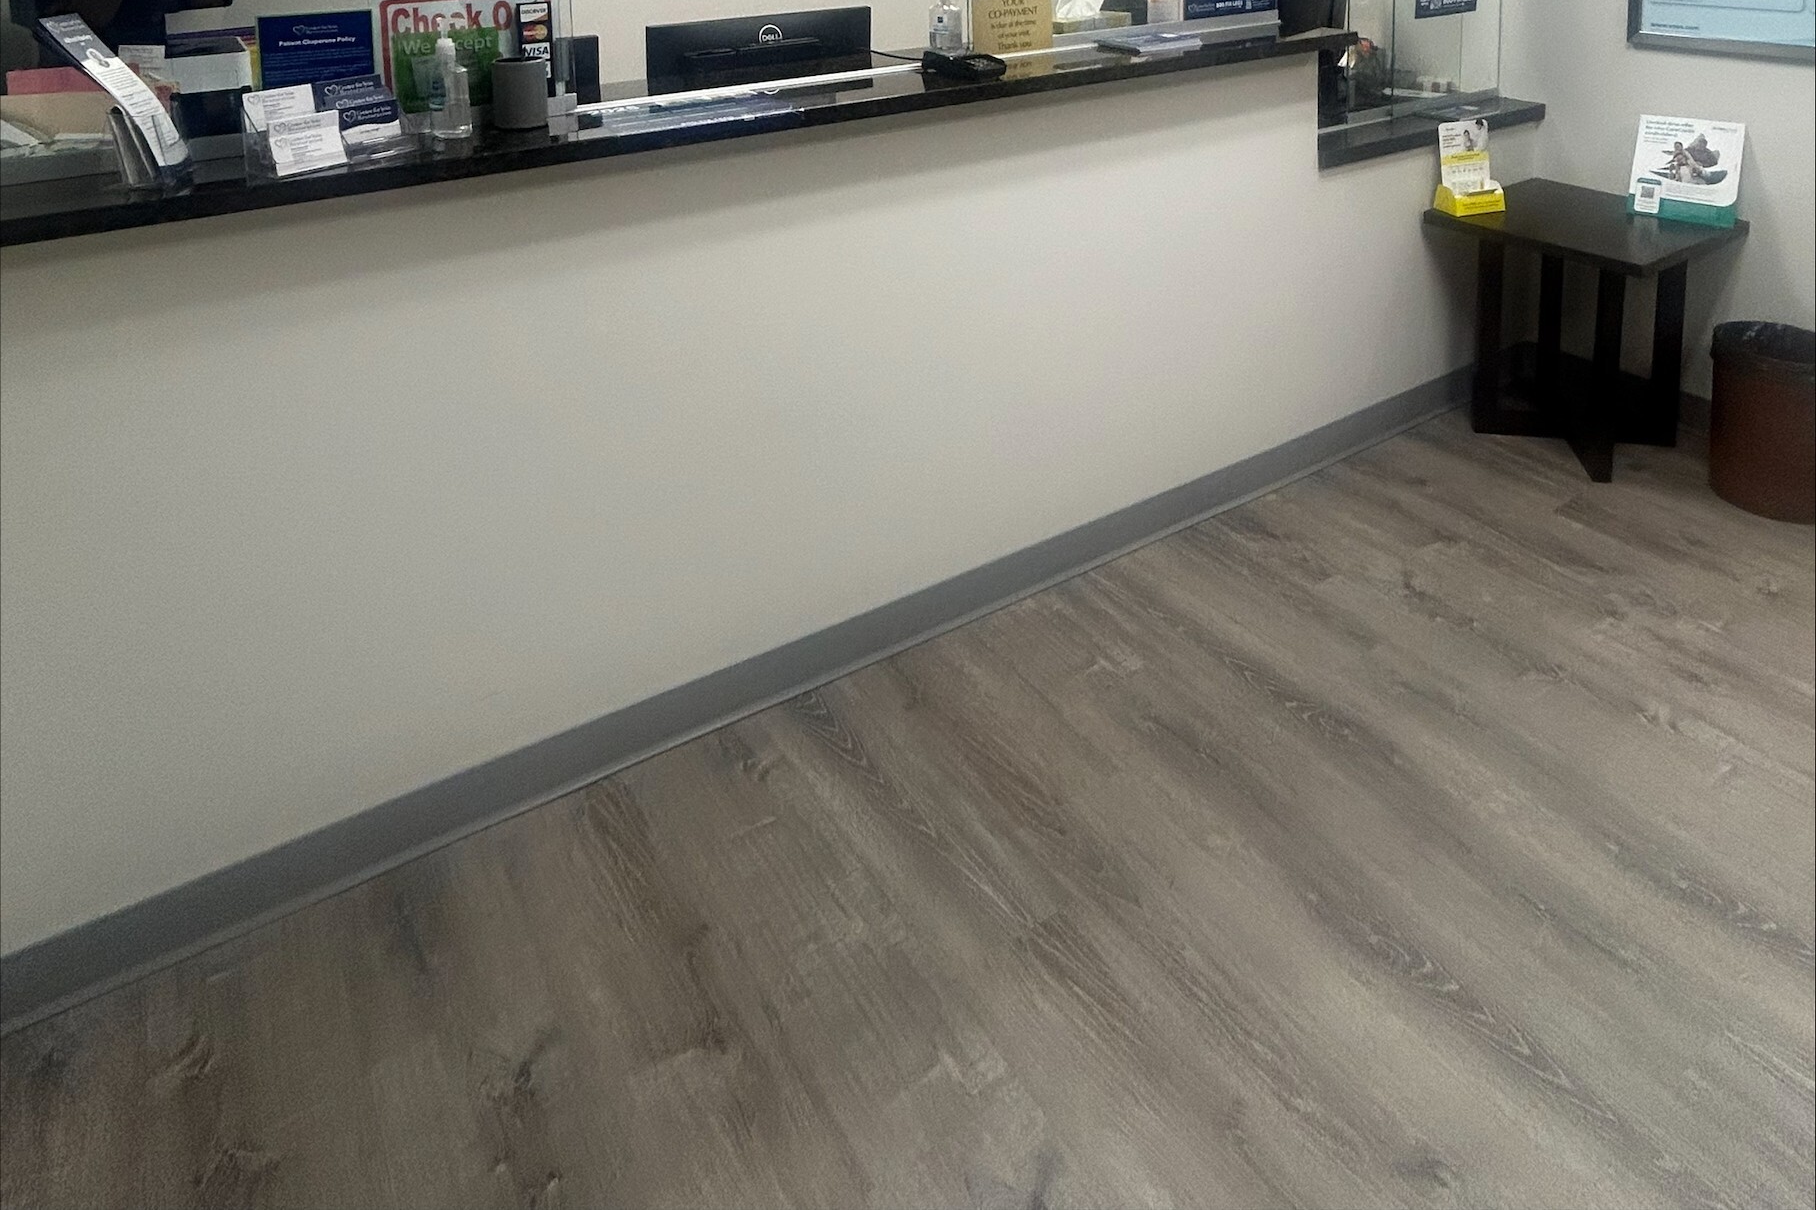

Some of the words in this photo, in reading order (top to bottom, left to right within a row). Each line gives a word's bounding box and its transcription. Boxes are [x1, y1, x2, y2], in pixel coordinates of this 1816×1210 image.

[988, 5, 1038, 19] CO-PAYMENT
[762, 33, 779, 41] DELL
[402, 39, 431, 55] We
[524, 47, 549, 56] VISA
